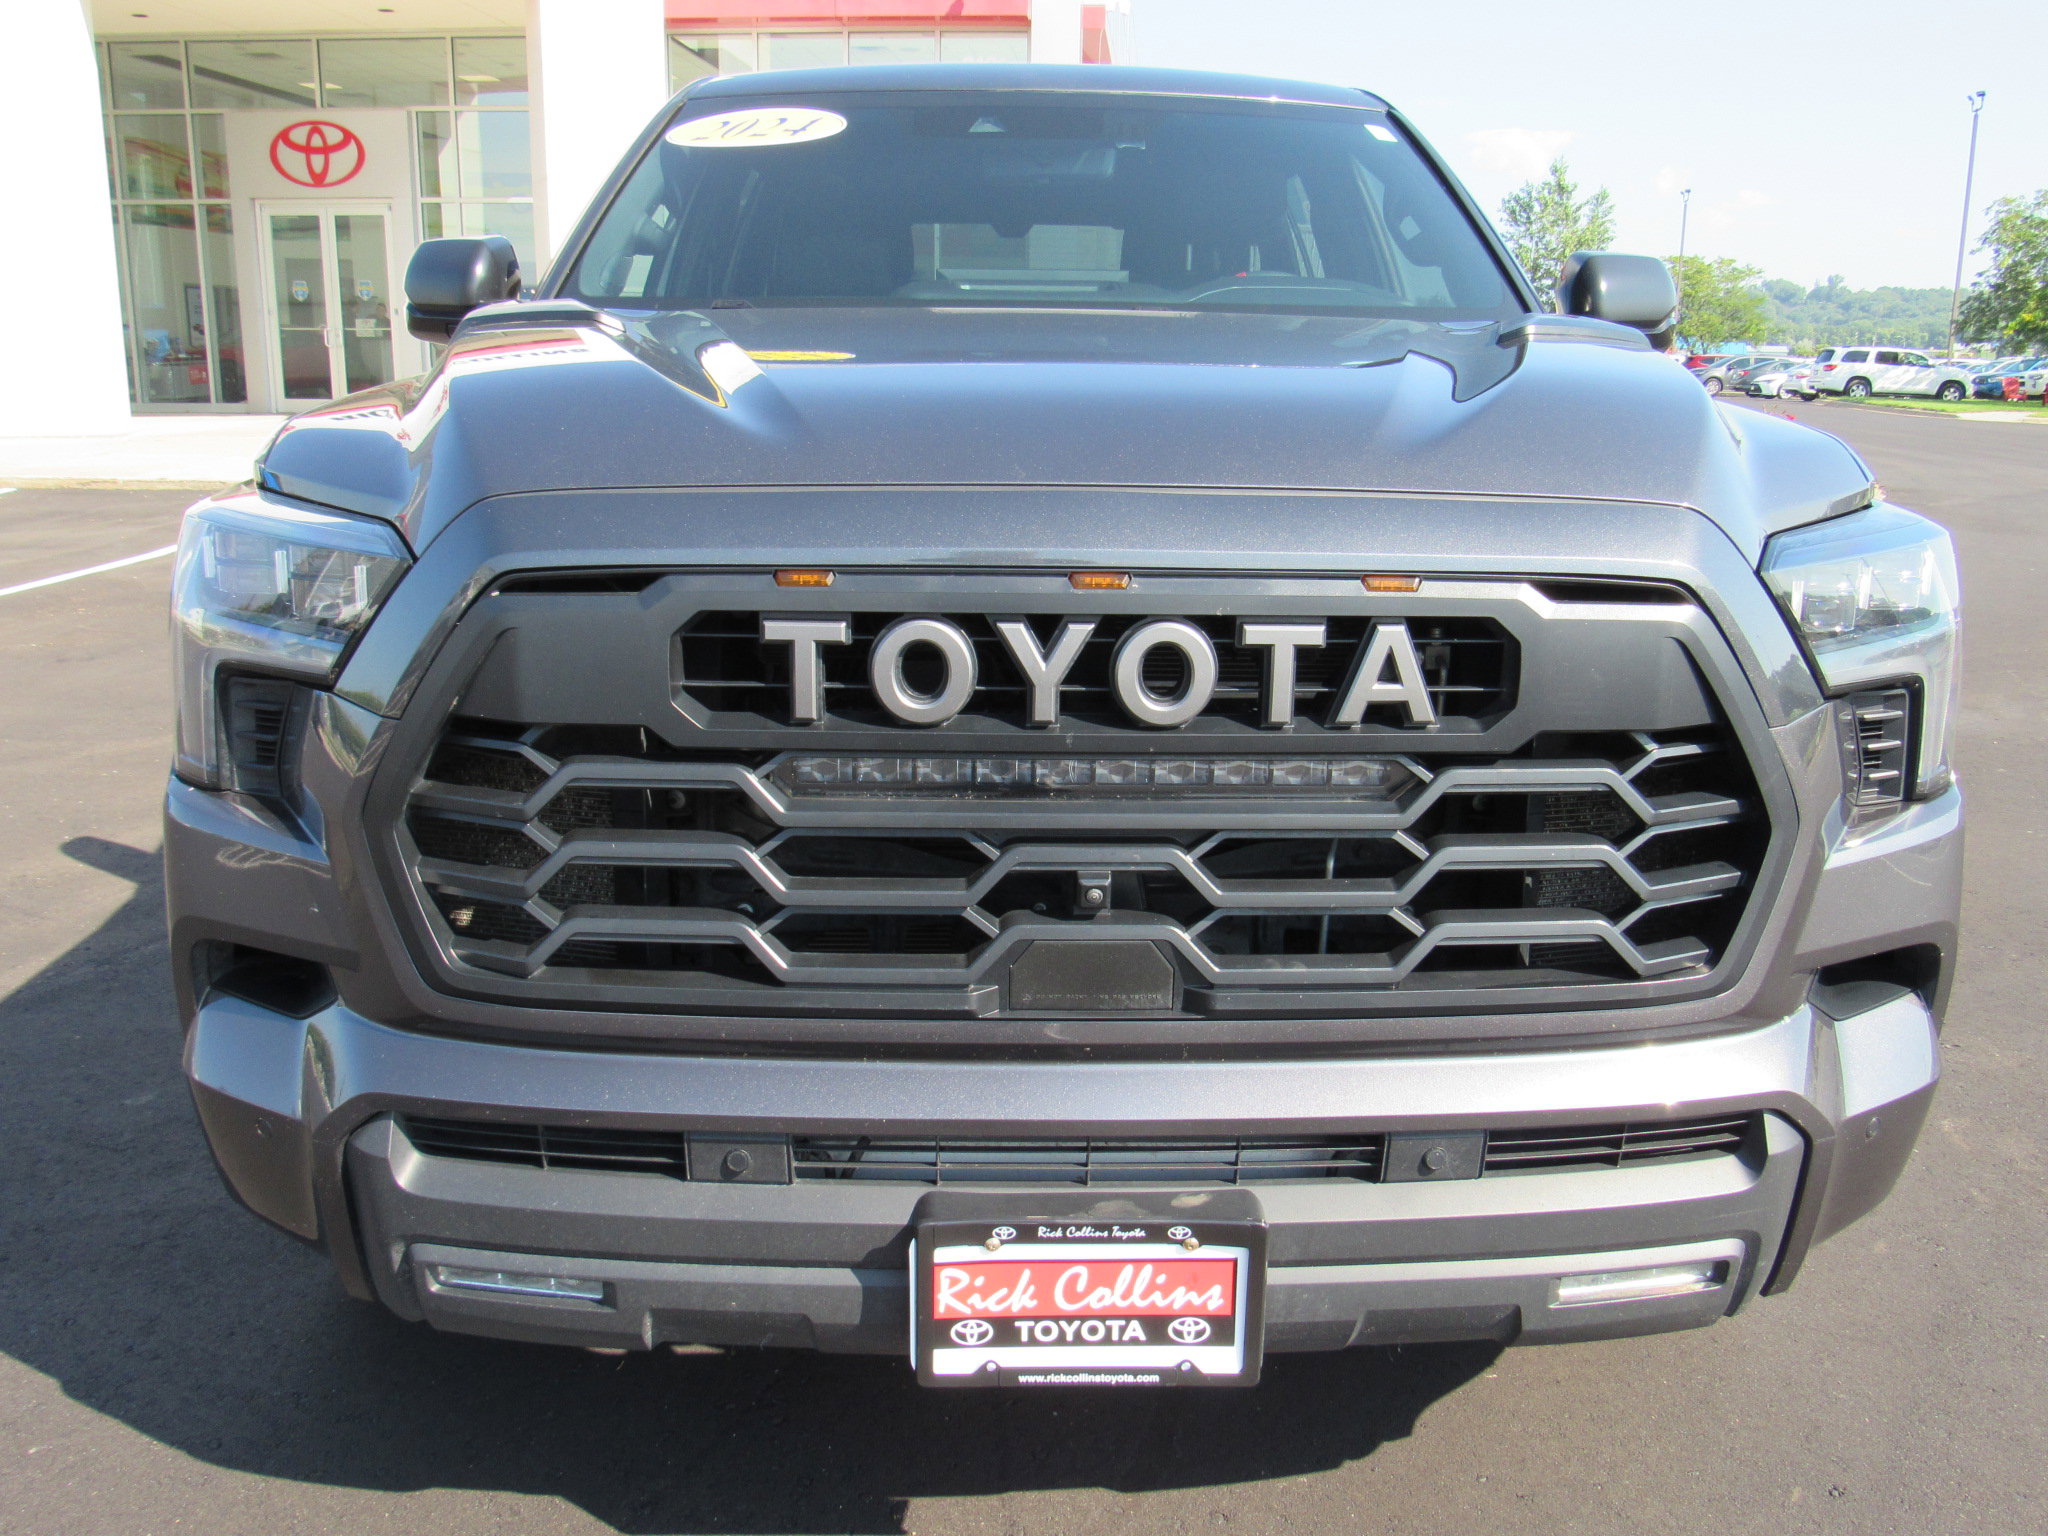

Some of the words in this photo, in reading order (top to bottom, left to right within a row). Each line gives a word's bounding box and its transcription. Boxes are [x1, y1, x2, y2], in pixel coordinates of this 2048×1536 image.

[761, 616, 1439, 727] TOYOTA
[1037, 1225, 1064, 1238] Rick
[1066, 1225, 1109, 1238] Collins
[1111, 1225, 1147, 1240] Toyota
[937, 1267, 1038, 1314] Rick
[1053, 1263, 1224, 1312] Collins
[1014, 1319, 1147, 1342] TOYOTA
[1017, 1372, 1160, 1385] www.rickcollinstoyota.com
